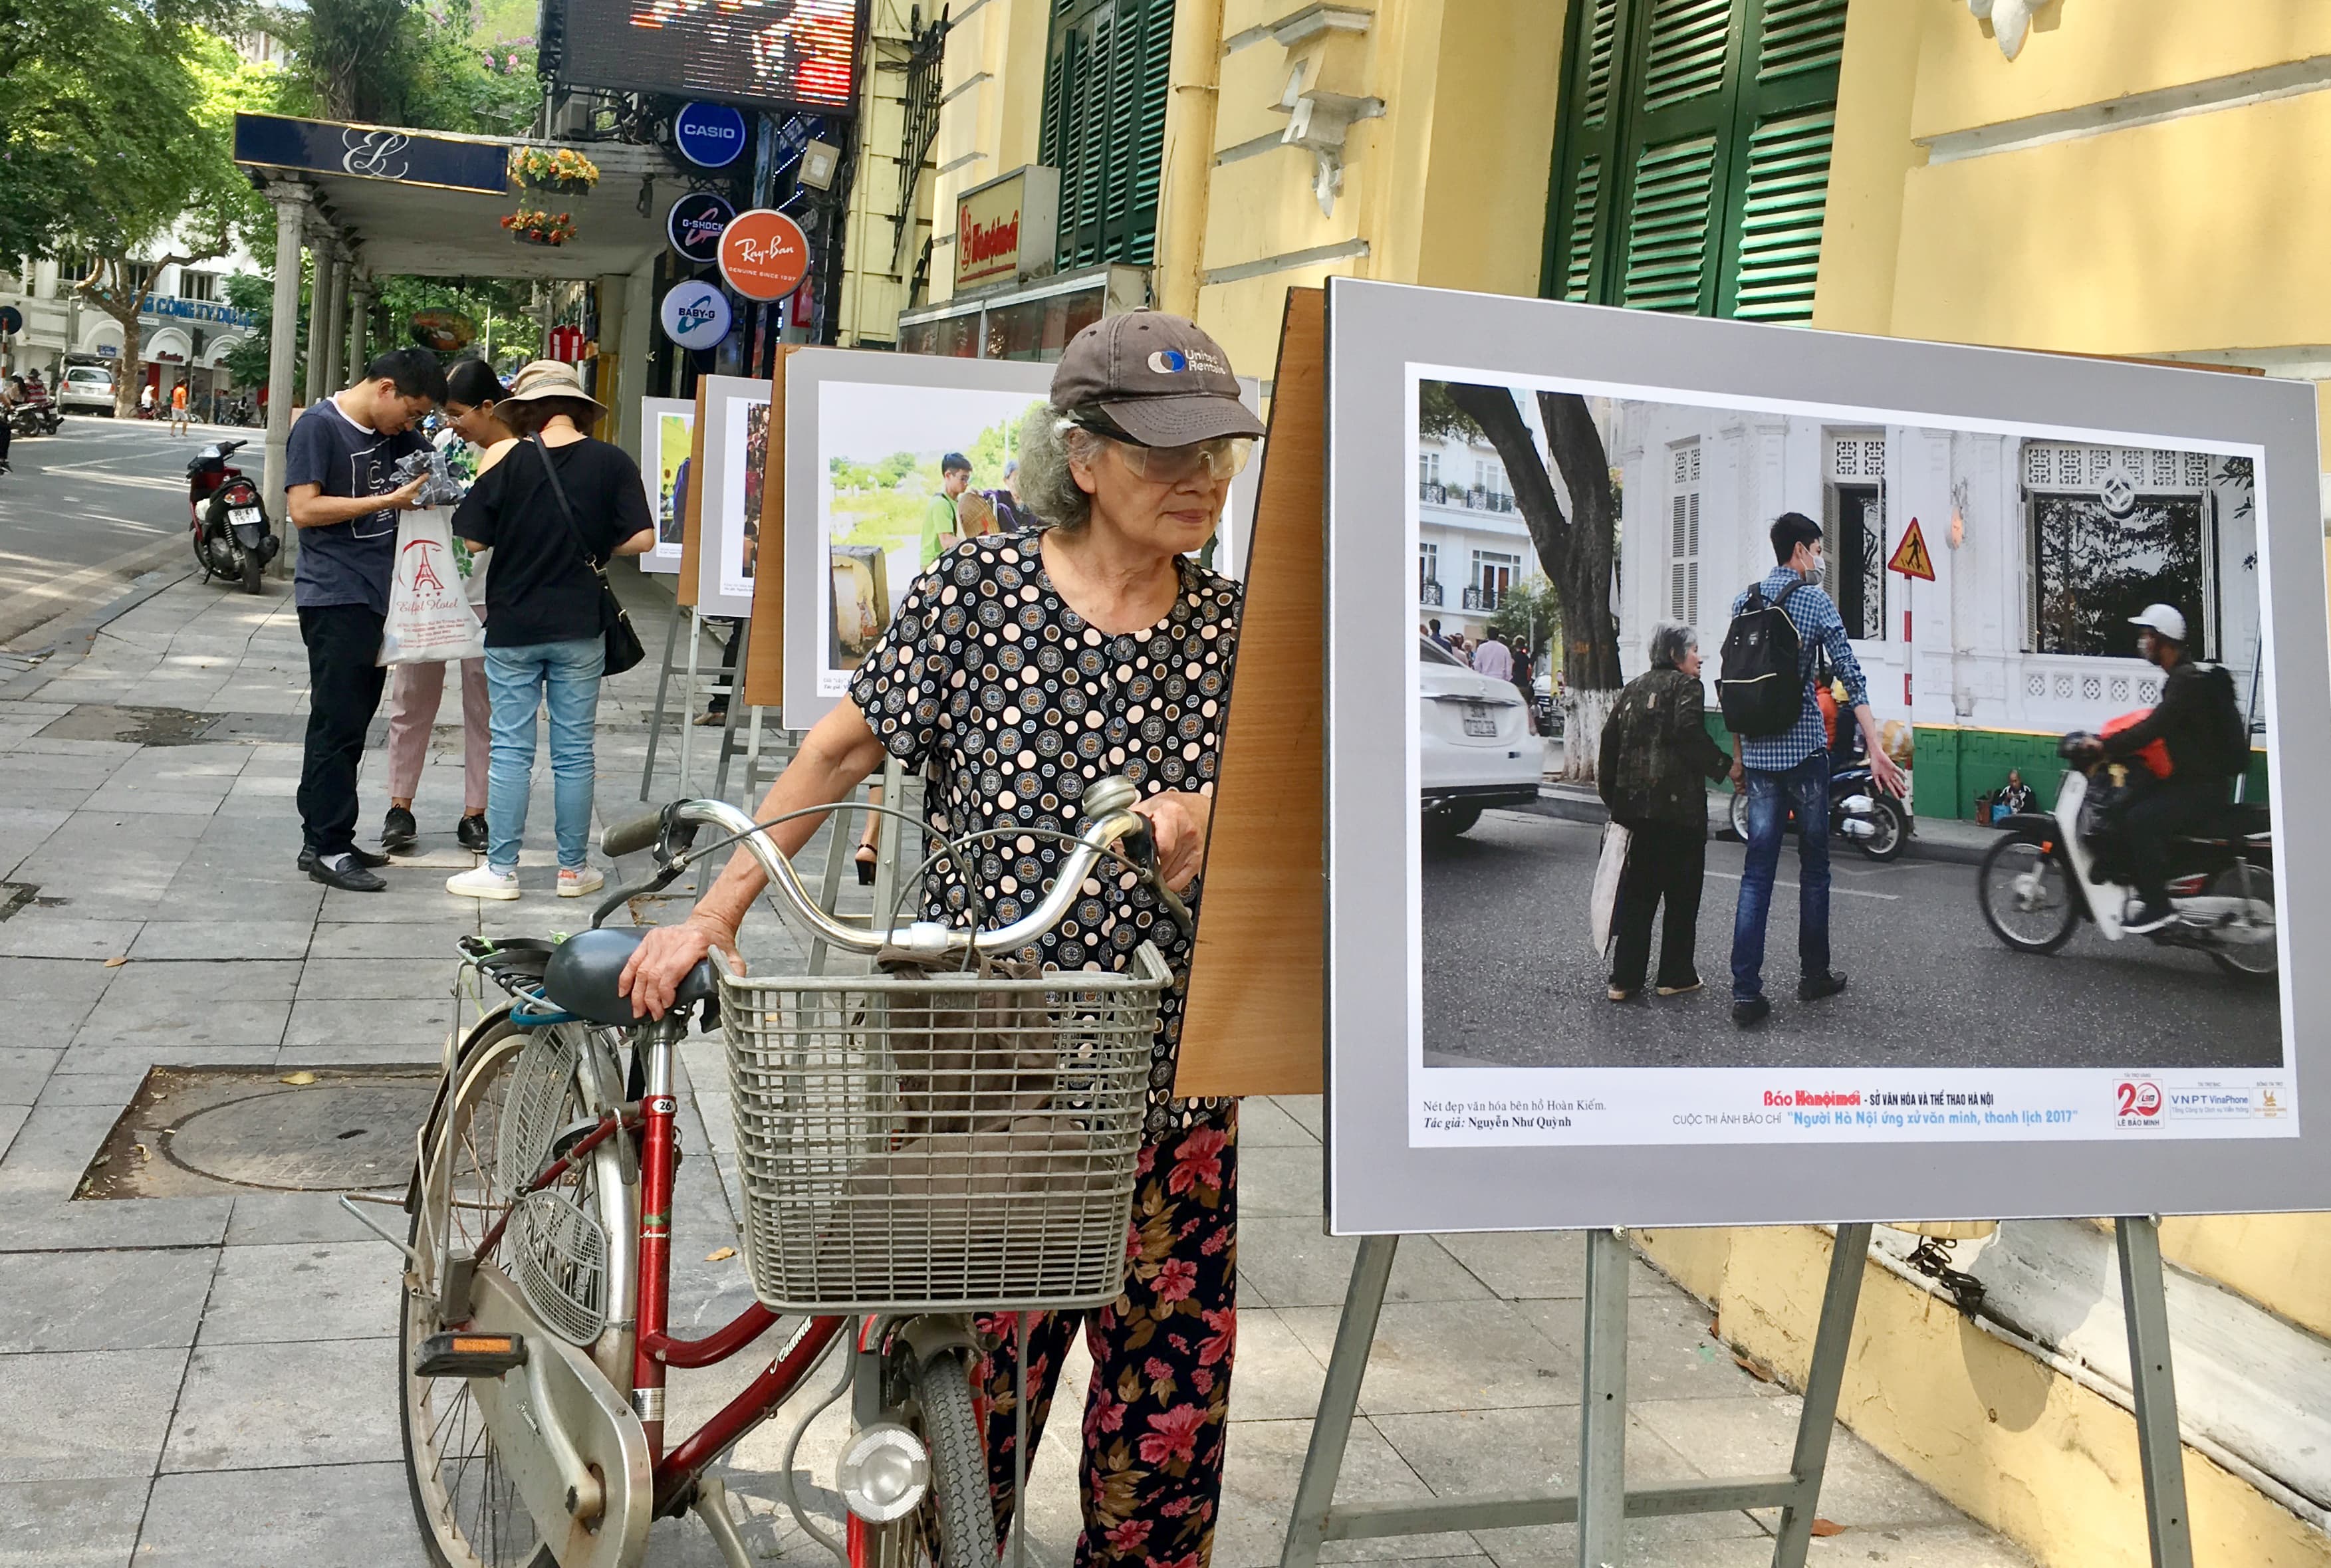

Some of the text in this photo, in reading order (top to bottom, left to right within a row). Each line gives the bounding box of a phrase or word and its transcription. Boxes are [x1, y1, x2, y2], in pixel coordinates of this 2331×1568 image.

[683, 124, 735, 139] CASIO
[682, 219, 724, 231] G-SHOCK
[728, 267, 757, 276] GENUINE
[678, 307, 715, 319] BABY-G
[1764, 1090, 1793, 1106] Báo
[1947, 1094, 1966, 1105] THAO
[2209, 1095, 2249, 1104] VinaPhone
[659, 1101, 672, 1111] 26
[1423, 1101, 1442, 1112] Nét
[1445, 1101, 1464, 1115] đẹp
[1489, 1100, 1507, 1111] hóa
[1547, 1099, 1574, 1111] Hoàn
[1424, 1117, 1443, 1128] Tác
[1468, 1115, 1509, 1131] Nguyễn
[1512, 1116, 1534, 1128] Như
[1536, 1116, 1572, 1129] Quỳnh
[1673, 1112, 1703, 1126] CUỘC
[1705, 1115, 1717, 1124] THI
[1834, 1112, 1852, 1124] Hà
[1856, 1111, 1878, 1128] Nội
[1985, 1111, 2019, 1124] thanh
[2023, 1109, 2042, 1127] lịch
